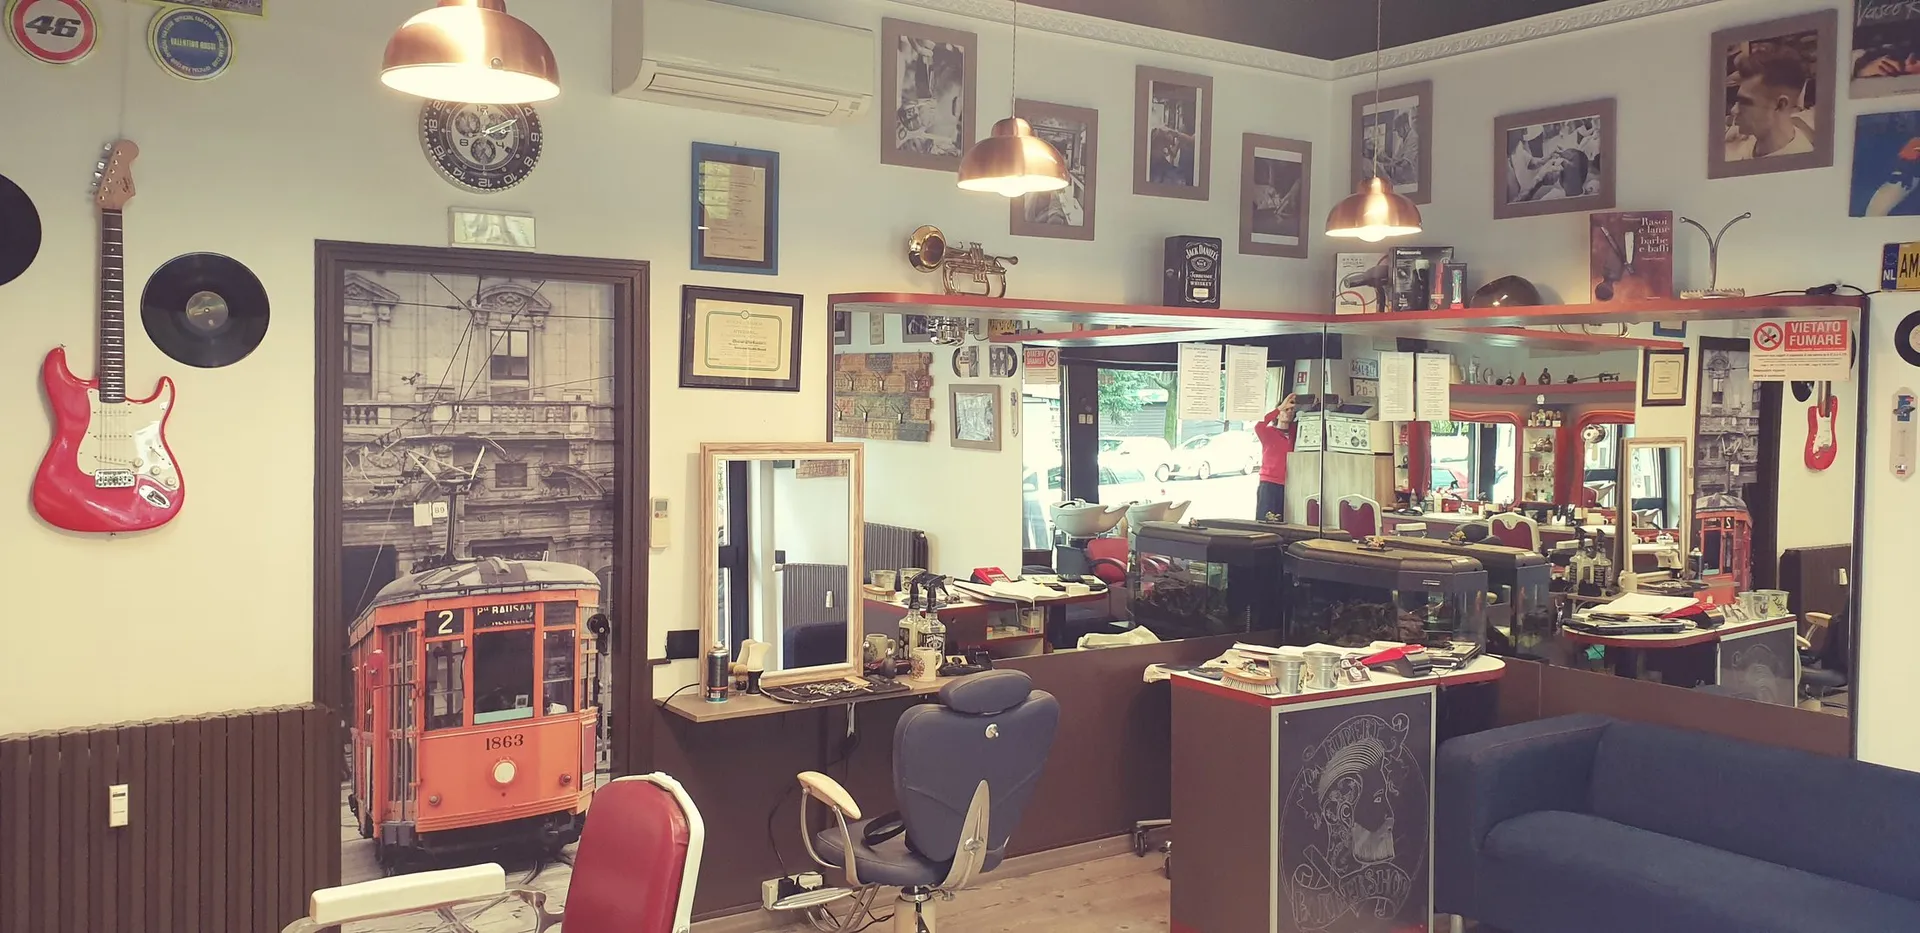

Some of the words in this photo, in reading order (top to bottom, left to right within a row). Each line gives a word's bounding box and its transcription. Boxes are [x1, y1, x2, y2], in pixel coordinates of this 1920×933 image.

[25, 15, 81, 38] 46
[524, 107, 533, 117] 4
[428, 119, 438, 134] 18
[523, 156, 534, 167] 8
[452, 167, 466, 181] 14
[503, 172, 518, 185] 10
[478, 177, 493, 188] 12
[1641, 217, 1667, 226] Rasoi
[1647, 225, 1670, 234] lame
[1640, 236, 1668, 245] barbe
[1185, 247, 1199, 260] JACK
[1899, 253, 1920, 278] AM
[1883, 269, 1896, 281] NL
[1791, 321, 1841, 333] VIETATO
[1789, 334, 1842, 346] FUMARE
[438, 610, 454, 635] 2
[486, 733, 524, 751] 1863
